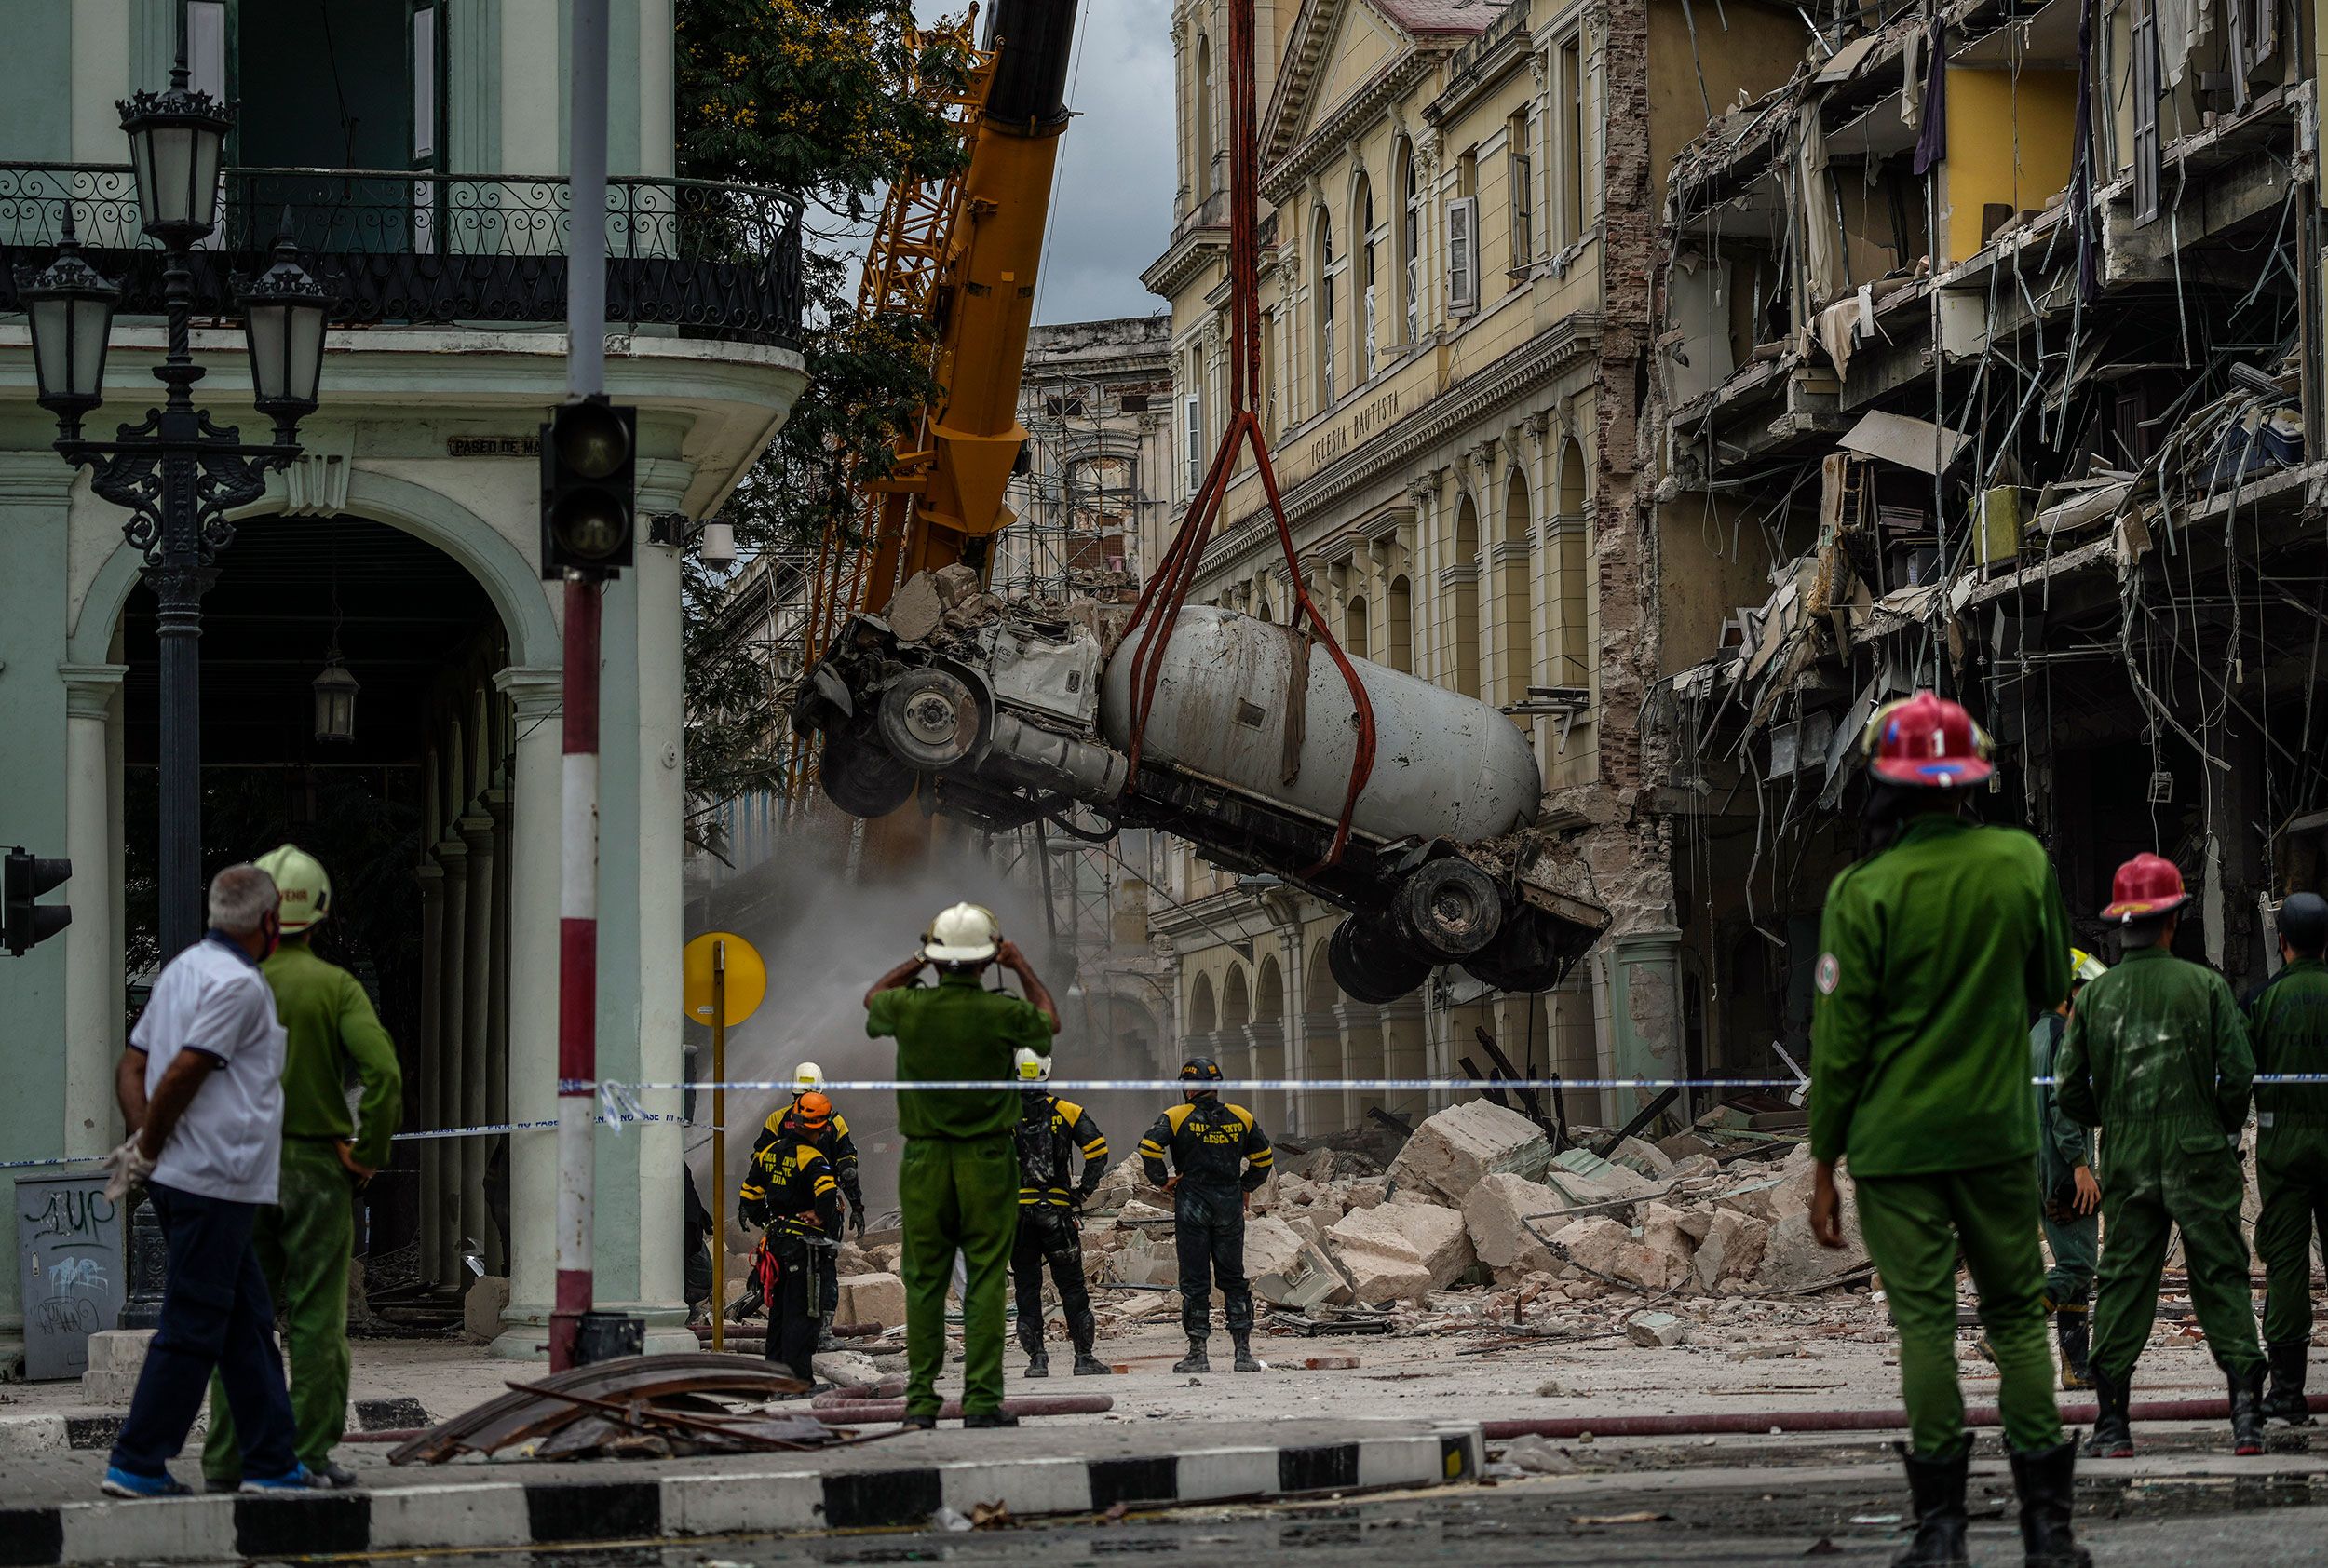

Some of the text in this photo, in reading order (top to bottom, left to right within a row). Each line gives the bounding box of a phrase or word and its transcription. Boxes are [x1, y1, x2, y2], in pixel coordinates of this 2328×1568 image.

[1311, 390, 1399, 466] IGLESIA BAUTISTA
[455, 439, 497, 453] PASEO
[501, 440, 518, 453] DE
[998, 646, 1011, 657] ECG
